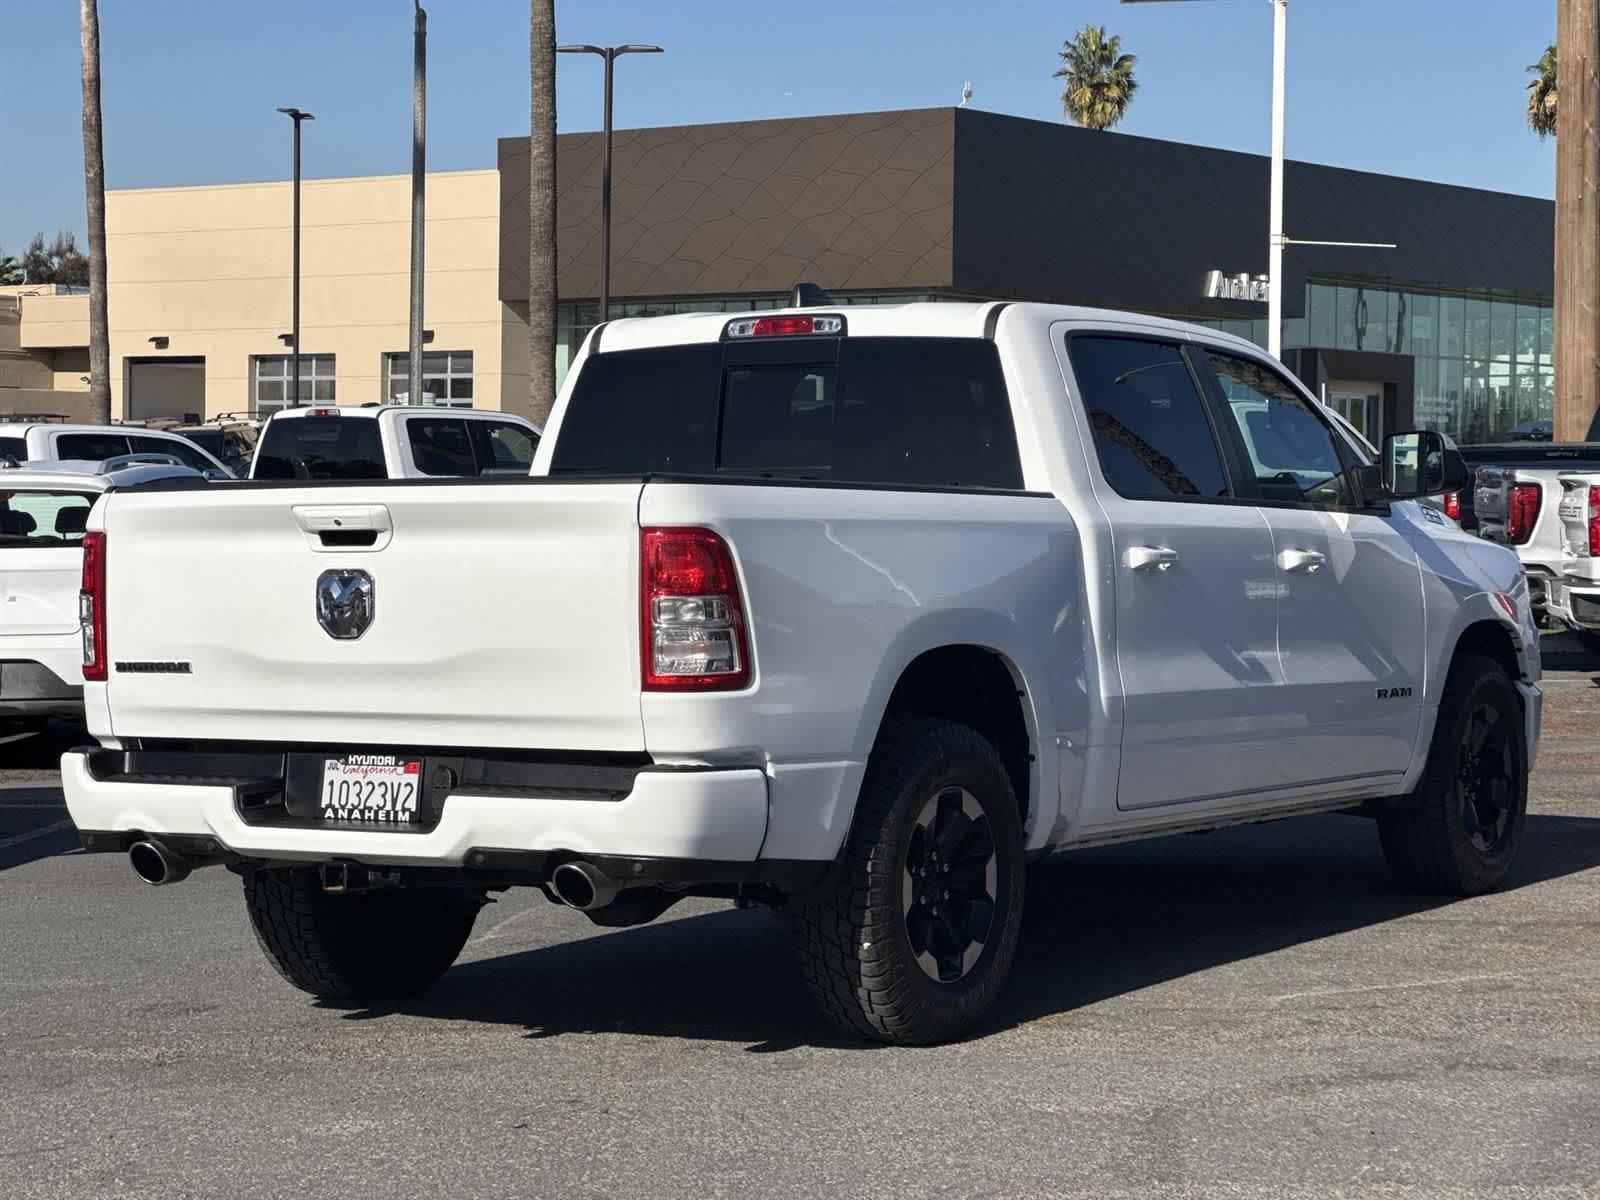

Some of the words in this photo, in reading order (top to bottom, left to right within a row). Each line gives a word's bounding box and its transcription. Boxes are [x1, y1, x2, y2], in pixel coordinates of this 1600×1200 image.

[1203, 270, 1270, 302] Anahei
[1377, 687, 1412, 699] RAM
[348, 754, 395, 766] HYUNDAI
[341, 765, 404, 779] California
[327, 778, 415, 811] 10323V2
[324, 808, 411, 823] ANAHEIM
